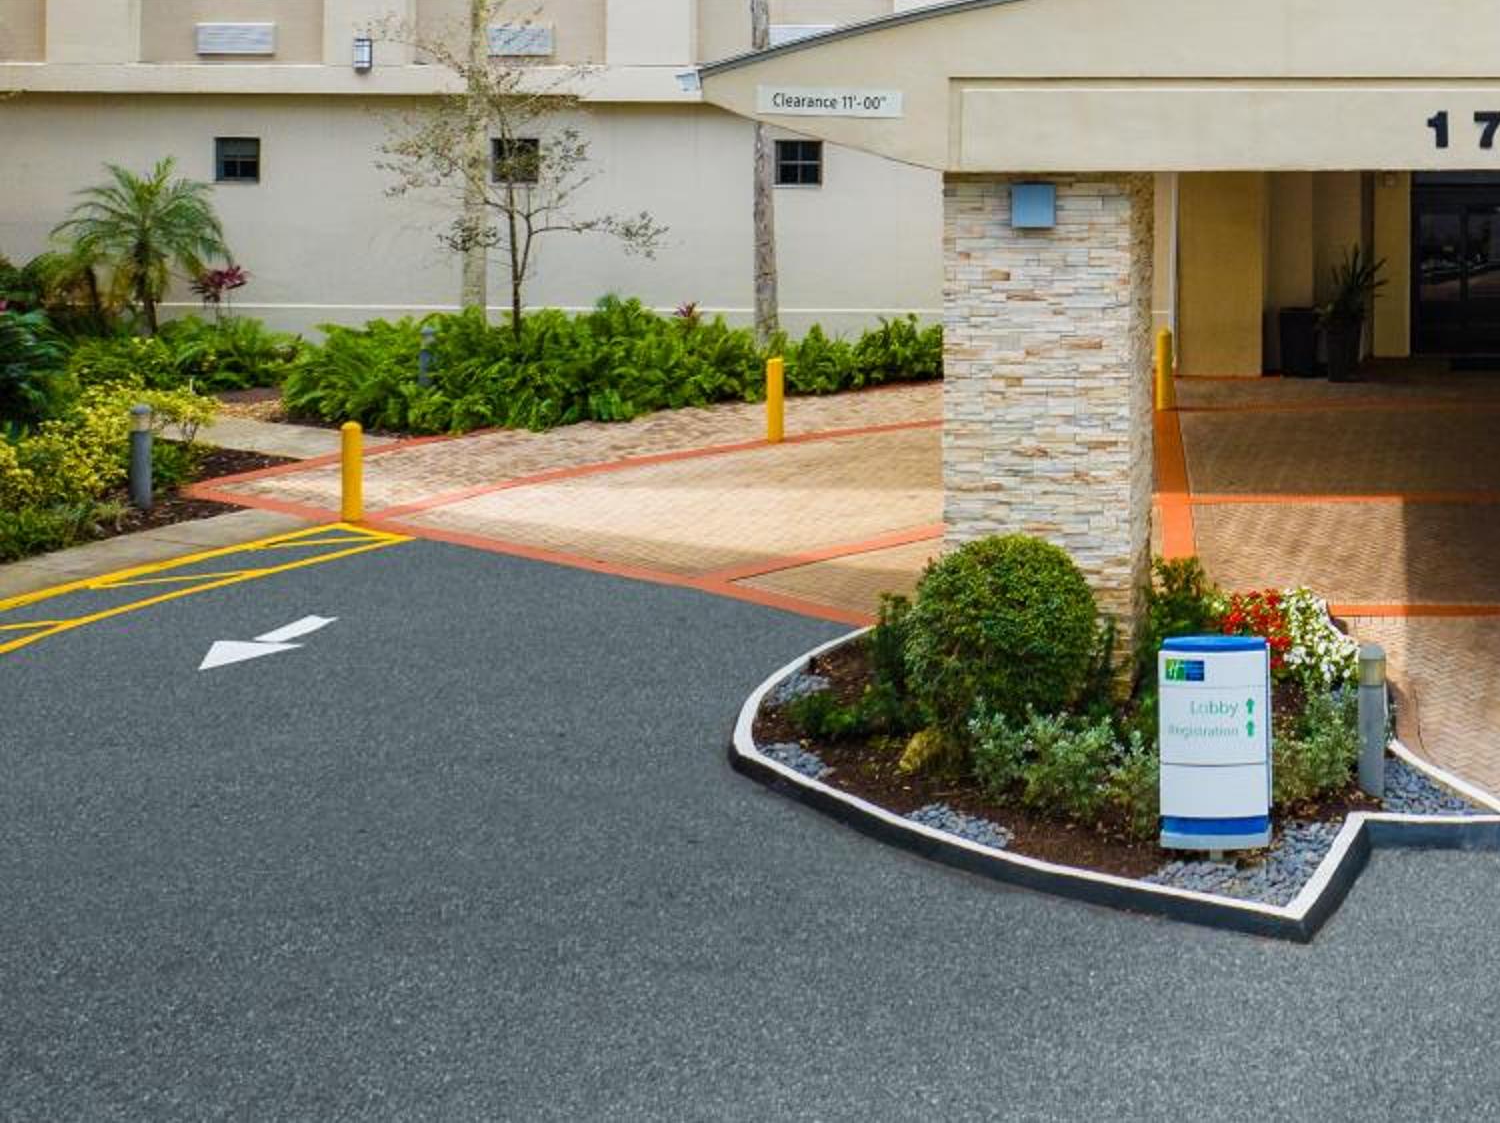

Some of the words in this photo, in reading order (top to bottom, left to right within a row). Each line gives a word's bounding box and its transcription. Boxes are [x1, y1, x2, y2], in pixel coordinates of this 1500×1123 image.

[772, 92, 838, 109] Clearance
[1190, 700, 1239, 718] Lobby
[1168, 724, 1239, 739] Registration
